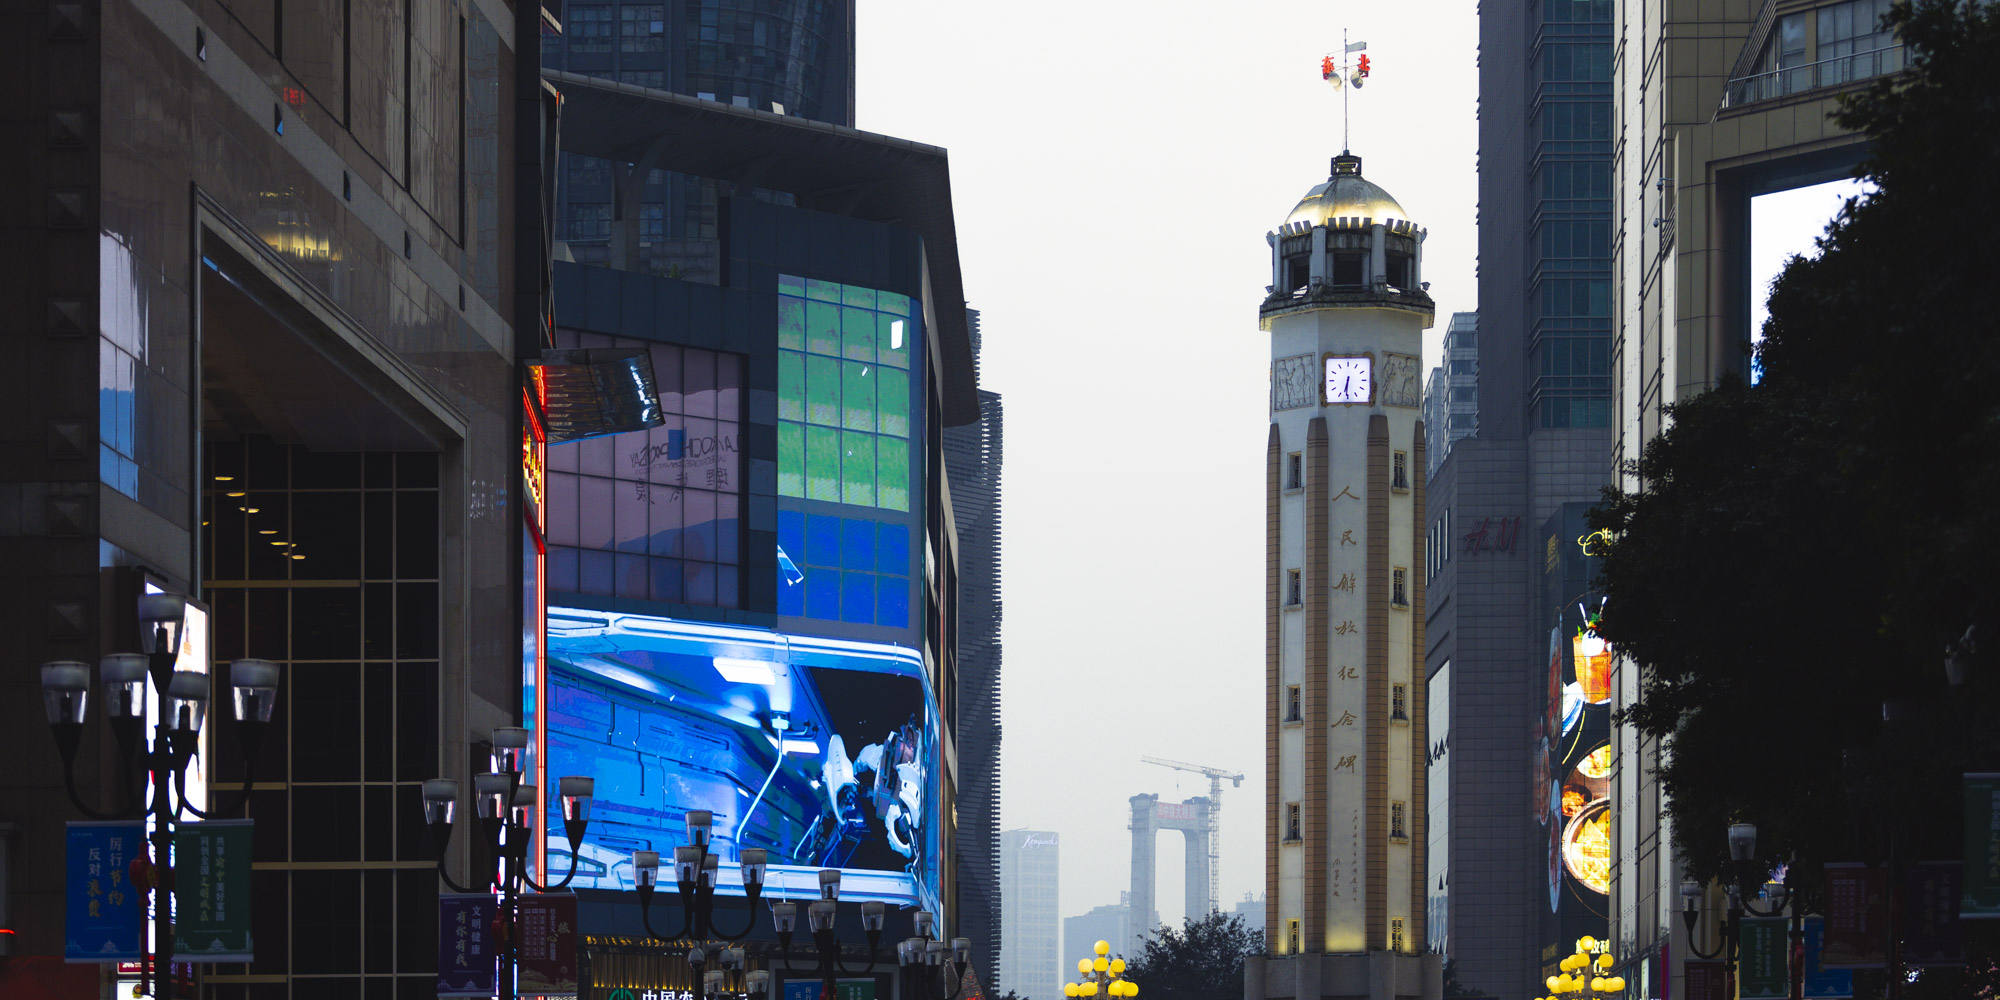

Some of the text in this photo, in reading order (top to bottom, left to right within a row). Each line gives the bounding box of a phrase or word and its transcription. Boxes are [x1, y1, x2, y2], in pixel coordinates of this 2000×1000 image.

[1464, 515, 1521, 553] H&M
[87, 847, 104, 918] 反对浪费
[108, 836, 125, 907] 厉行节约
[455, 910, 468, 967] 有你有我
[471, 905, 482, 955] 文明健康
